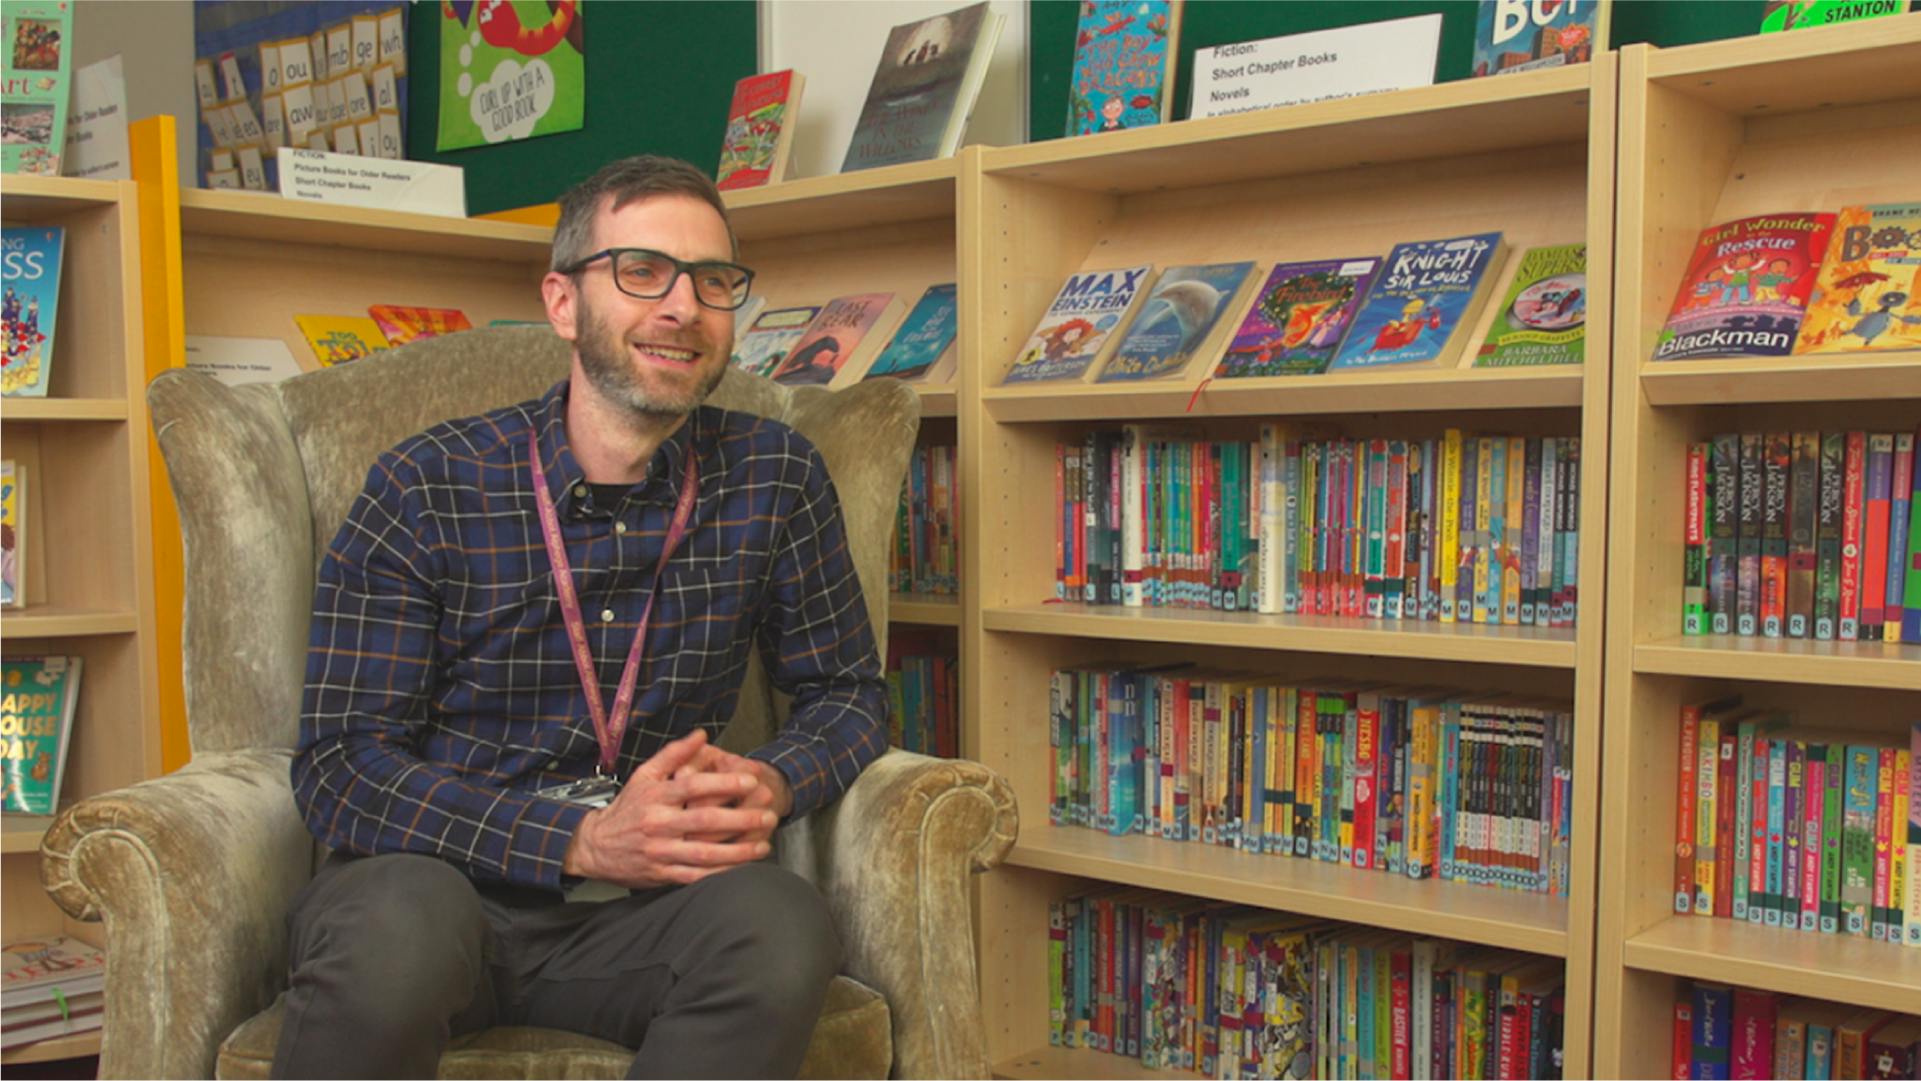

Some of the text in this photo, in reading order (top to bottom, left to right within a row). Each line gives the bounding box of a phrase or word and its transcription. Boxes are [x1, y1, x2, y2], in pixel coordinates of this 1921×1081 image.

[1825, 1, 1896, 24] STANTON
[356, 40, 373, 66] ge
[1213, 42, 1258, 59] Fiction:
[286, 63, 308, 81] ou
[1211, 51, 1338, 81] Short Chapter Books
[479, 65, 546, 115] CURL UP WITH A
[1209, 86, 1250, 103] Novels
[289, 105, 314, 126] aw
[491, 93, 538, 133] GOOD BOOK
[293, 163, 322, 174] Picture
[322, 165, 347, 177] Books
[359, 170, 381, 179] Older
[380, 172, 412, 183] Readers
[294, 177, 372, 192] Short Chapter Books
[1745, 217, 1827, 234] Wonder
[1393, 239, 1489, 276] KNIGHT
[1717, 237, 1797, 258] Rescue
[1059, 266, 1148, 298] MAX
[1384, 274, 1417, 291] SIR
[1418, 270, 1473, 286] LOUIS
[1051, 292, 1134, 313] EINSTEIN
[1657, 328, 1791, 357] Blackman
[1715, 462, 1731, 524] JACKSON
[1741, 459, 1756, 522] JACKSON
[1751, 473, 1760, 512] PERCY
[1765, 459, 1781, 522] JACKSON
[1776, 473, 1786, 513] PERCY
[1820, 460, 1836, 525] JACKSON
[1831, 474, 1841, 513] PERCY
[1688, 619, 1697, 630] R
[1716, 618, 1725, 630] R
[1742, 620, 1751, 631] R
[1767, 620, 1777, 632] R
[1792, 619, 1802, 630] R
[1820, 624, 1830, 635] R
[1843, 622, 1853, 633] R
[1699, 749, 1714, 798] AKIMBO
[1789, 762, 1802, 788] GUM
[1879, 767, 1892, 793] GUM
[1752, 861, 1760, 892] STANTON
[1786, 849, 1797, 898] ANDY STANTON
[1805, 854, 1816, 904] ANDY STANTON
[1876, 857, 1887, 907] ANDY STANTON
[1678, 897, 1687, 909] S
[1698, 897, 1707, 909] S
[1736, 902, 1745, 913] S
[1750, 909, 1760, 920] S
[1767, 911, 1776, 922] S
[1785, 913, 1795, 924] S
[1804, 916, 1813, 926] S
[1823, 918, 1833, 929] S
[1851, 918, 1861, 930] S
[1874, 926, 1883, 936] S
[1891, 928, 1900, 939] S
[1911, 928, 1920, 940] S
